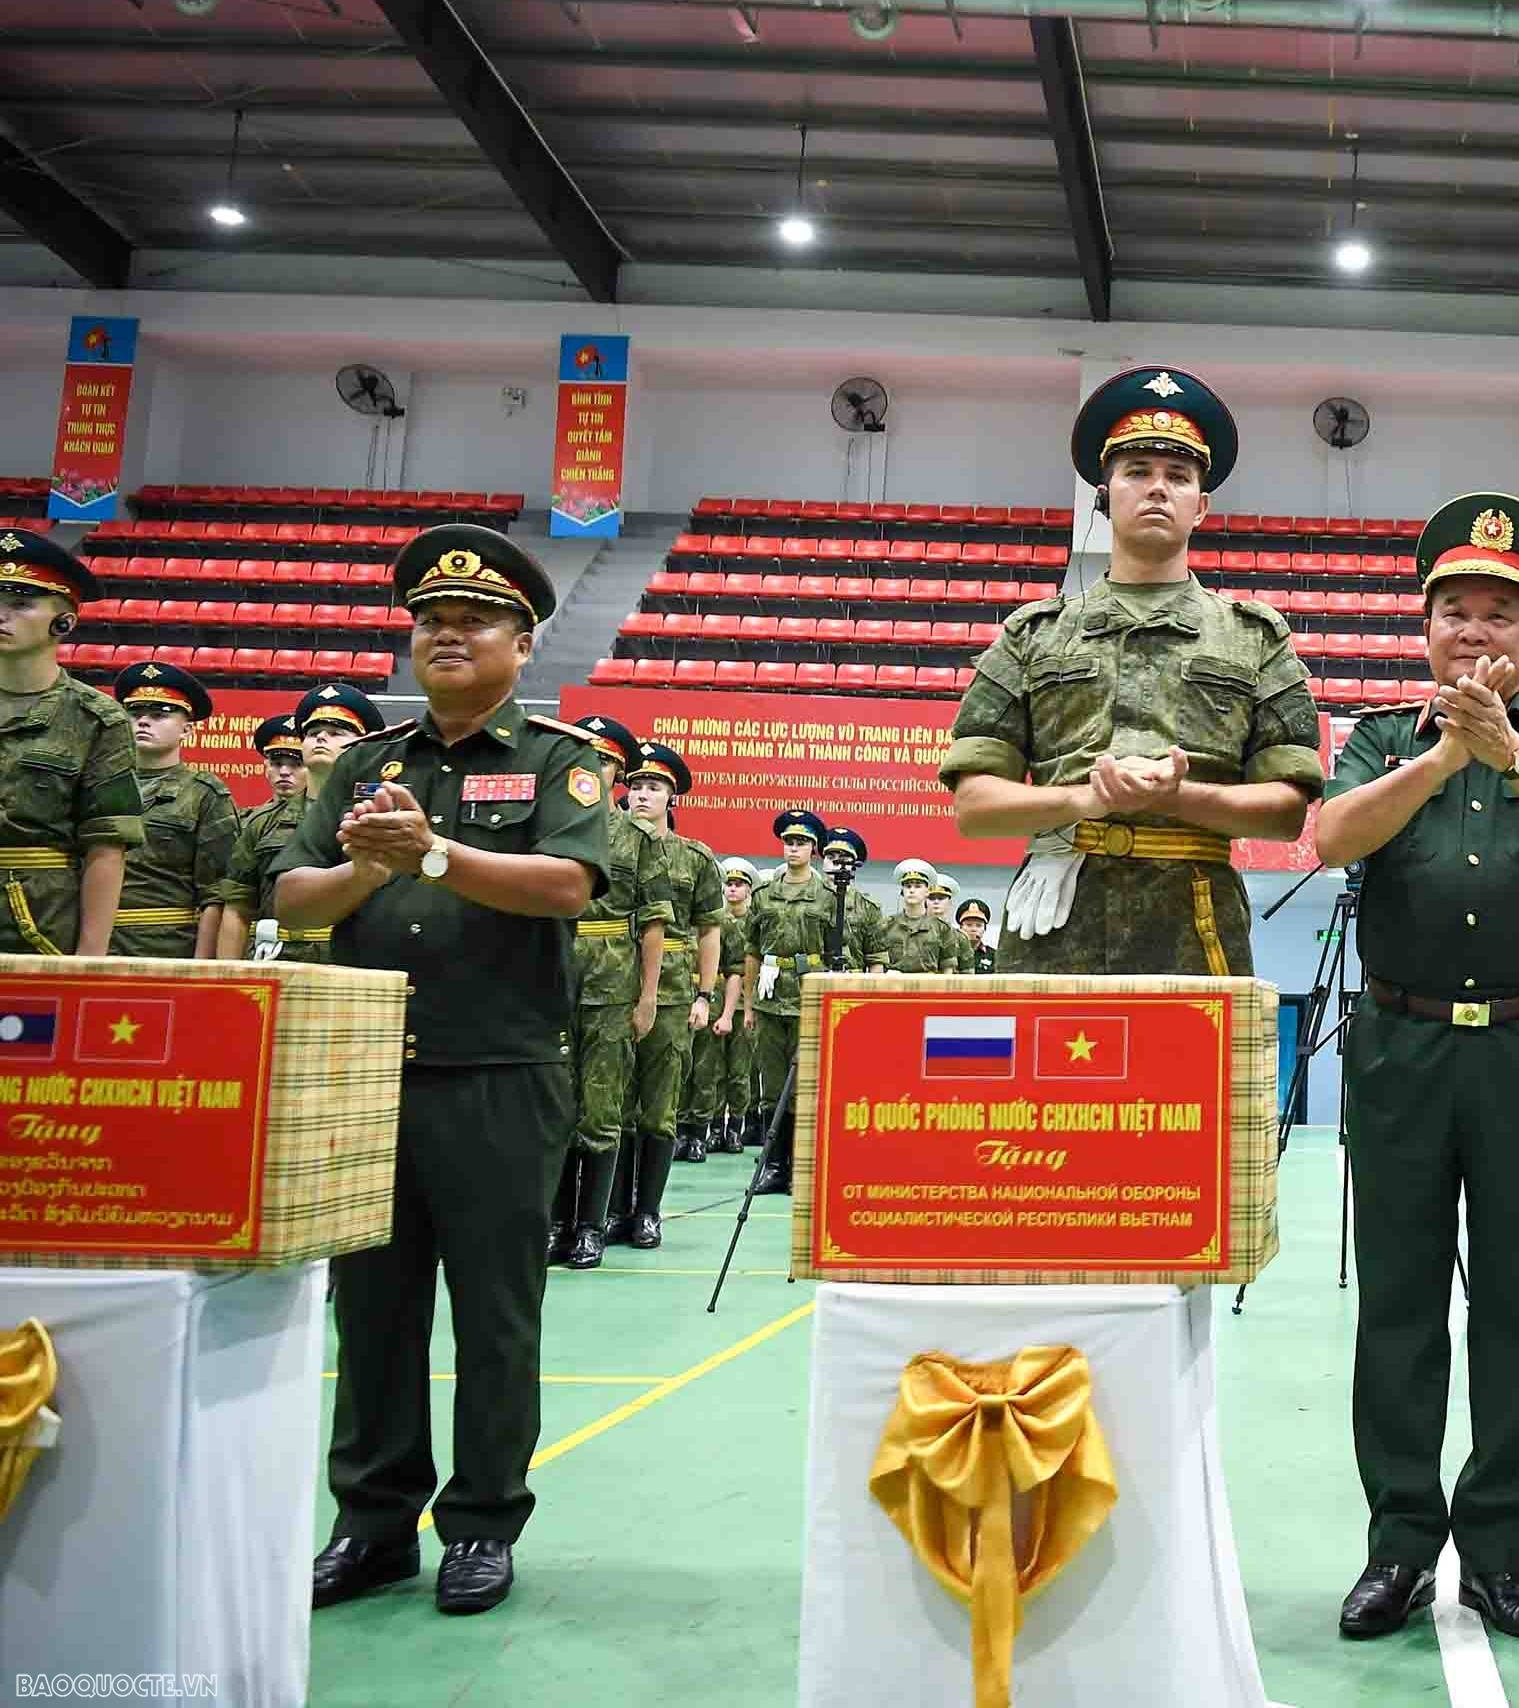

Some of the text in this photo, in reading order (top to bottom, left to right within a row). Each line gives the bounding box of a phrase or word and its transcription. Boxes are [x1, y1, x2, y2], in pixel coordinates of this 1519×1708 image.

[200, 733, 241, 749] NGHĨA
[653, 715, 689, 735] CHÀO
[692, 716, 731, 737] MỪNG
[734, 718, 761, 737] CÁC
[763, 720, 789, 741] LỰC
[791, 721, 834, 743] LƯỢNG
[858, 725, 900, 744] TRANG
[903, 725, 933, 744] LIÊN
[688, 738, 728, 760] MẠNG
[731, 738, 774, 759] THÁNG
[777, 739, 805, 760] TÁM
[808, 741, 851, 762] THÀNH
[854, 743, 890, 763] CÔNG
[894, 744, 911, 764] VÀ
[921, 803, 954, 817] НЕЗАВ
[0, 1071, 242, 1115] NG NƯỚC CHXHCN VIỆT NAM
[8, 1112, 103, 1145] Tặng
[845, 1092, 1201, 1138] BỘ QUỐC PHÒNG NƯỚC CHXHCN VIỆT NAM
[975, 1140, 1068, 1172] Tặng
[843, 1183, 1201, 1201] ОТ МИНИСТЕРСТВА НАЦИОНАЛЬНОЙ ОБОРОНЫ
[850, 1208, 1013, 1228] СОЦИАЛИСТИЧЕСКОЙ
[1016, 1212, 1117, 1228] РЕСПУБЛИКИ
